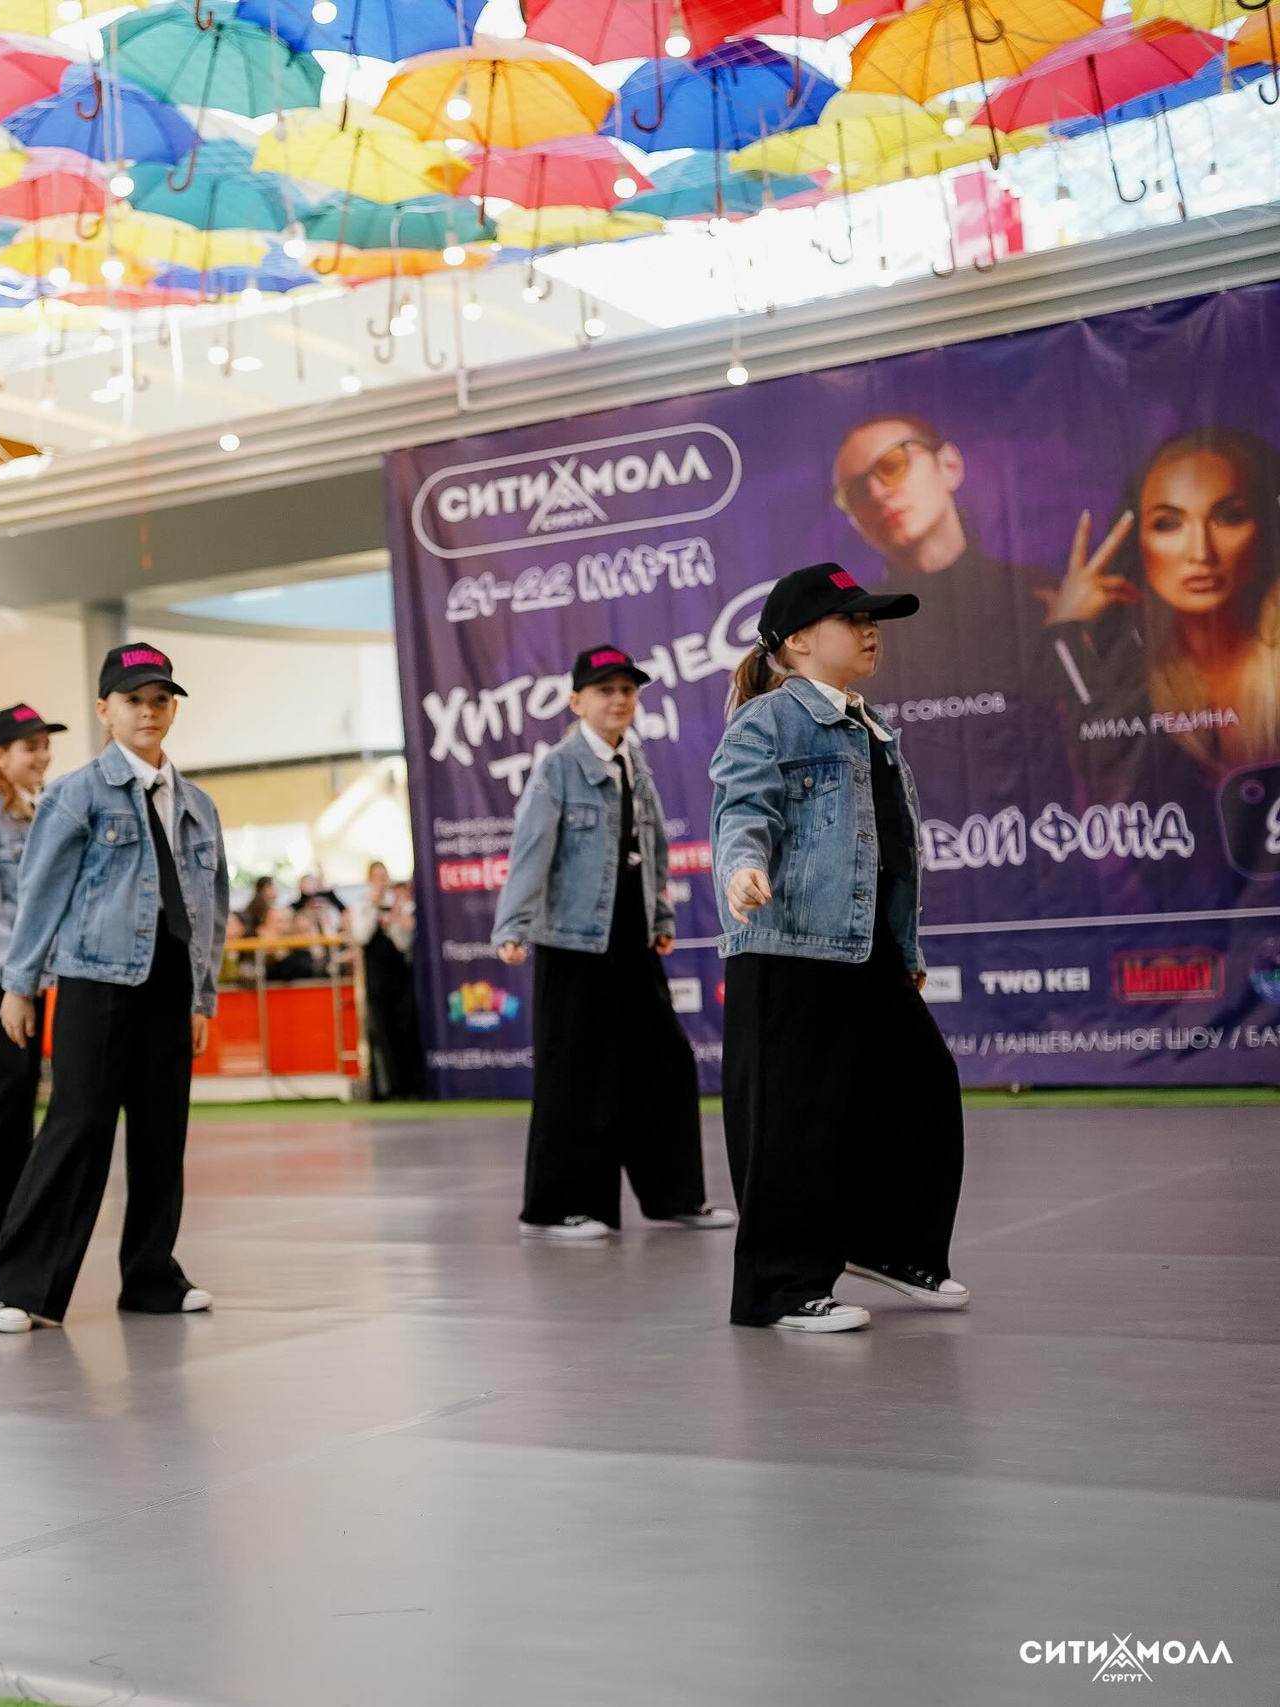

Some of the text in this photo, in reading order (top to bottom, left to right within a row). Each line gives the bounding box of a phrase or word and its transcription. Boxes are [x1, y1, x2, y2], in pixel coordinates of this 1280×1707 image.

[900, 691, 1007, 723] СОКОЛОВ
[1080, 707, 1240, 741] МИЛА РЕДИНА
[920, 805, 1027, 872] ВОЙ
[1030, 801, 1195, 863] ФОНД
[978, 969, 1044, 996] TWO
[994, 1027, 1162, 1056] ТАНЦЕВАЛЬНОЕ
[1165, 1025, 1224, 1050] ШОУ
